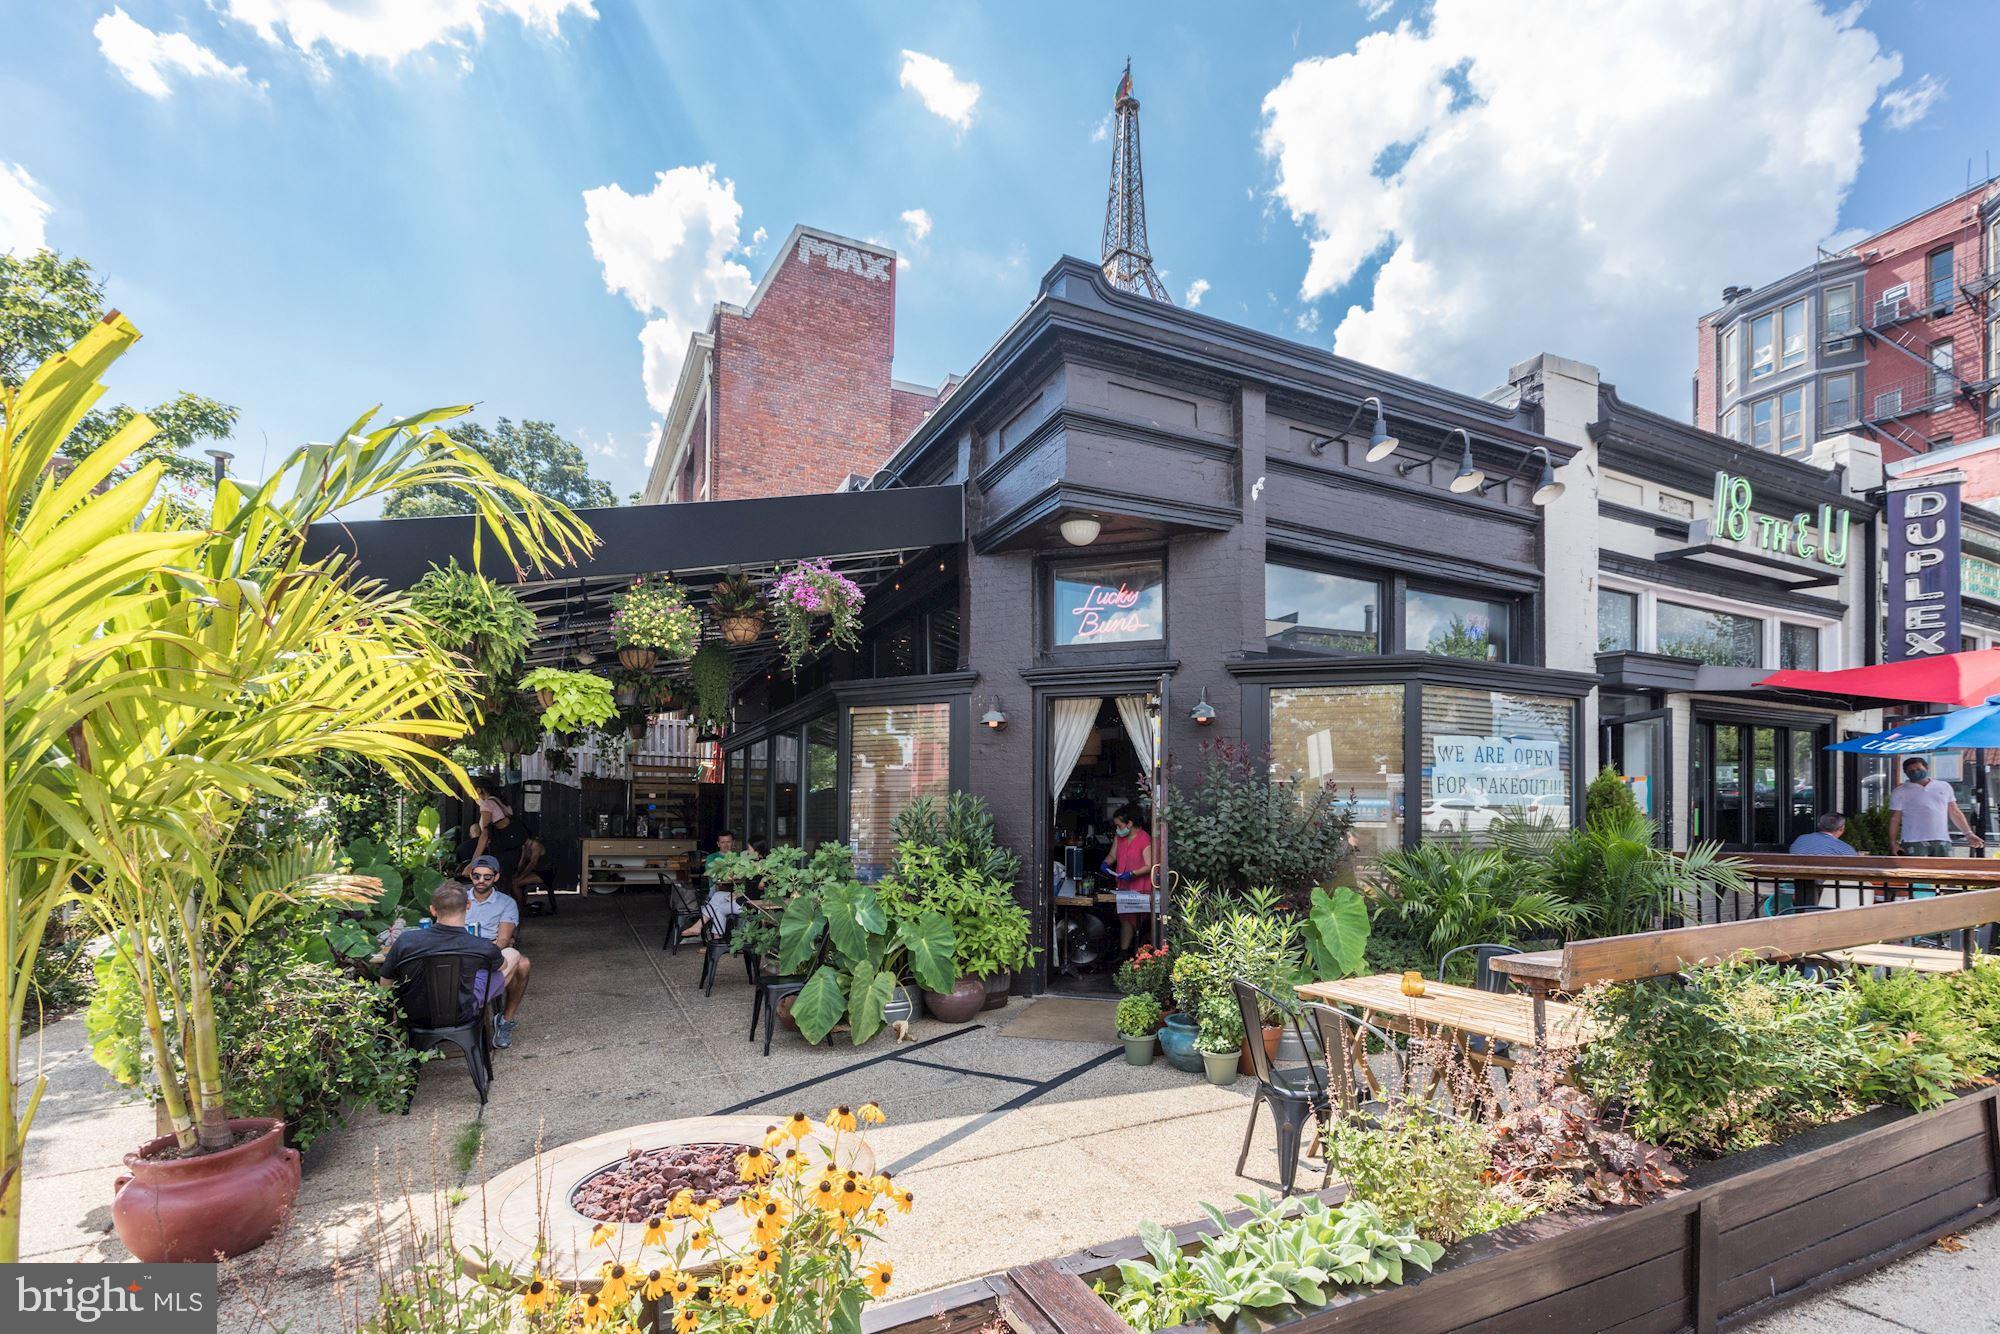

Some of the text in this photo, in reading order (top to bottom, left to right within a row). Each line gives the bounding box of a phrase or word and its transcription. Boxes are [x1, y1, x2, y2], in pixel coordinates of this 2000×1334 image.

[798, 235, 891, 282] MAX
[1716, 473, 1752, 541] 18
[1904, 491, 1948, 656] DUPLEX
[1072, 583, 1140, 615] Lucky
[1078, 612, 1150, 637] Buns
[1437, 745, 1554, 767] WE ARE OPEN
[1436, 776, 1468, 794] FOR
